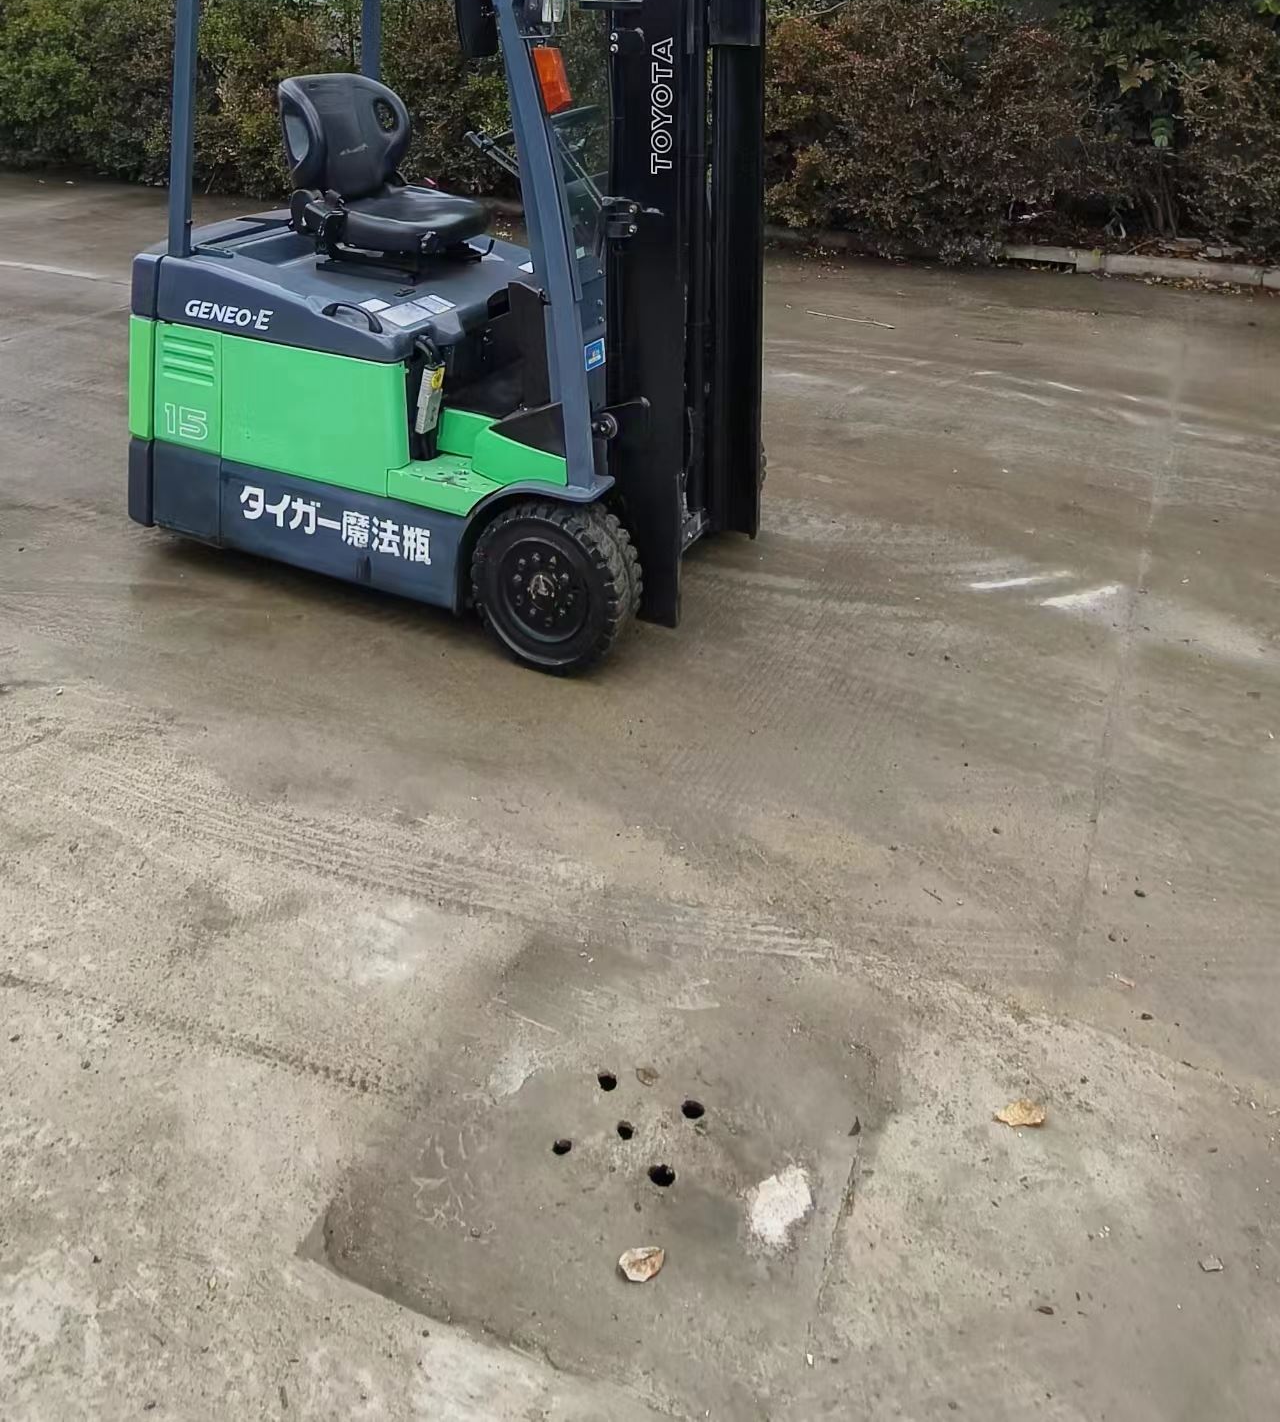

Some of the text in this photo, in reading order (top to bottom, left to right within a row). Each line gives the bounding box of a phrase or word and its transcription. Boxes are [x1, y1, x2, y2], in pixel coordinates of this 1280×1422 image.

[651, 37, 673, 175] TOYOTA
[164, 402, 208, 441] 15
[239, 485, 432, 566] タイガー魔法瓶
